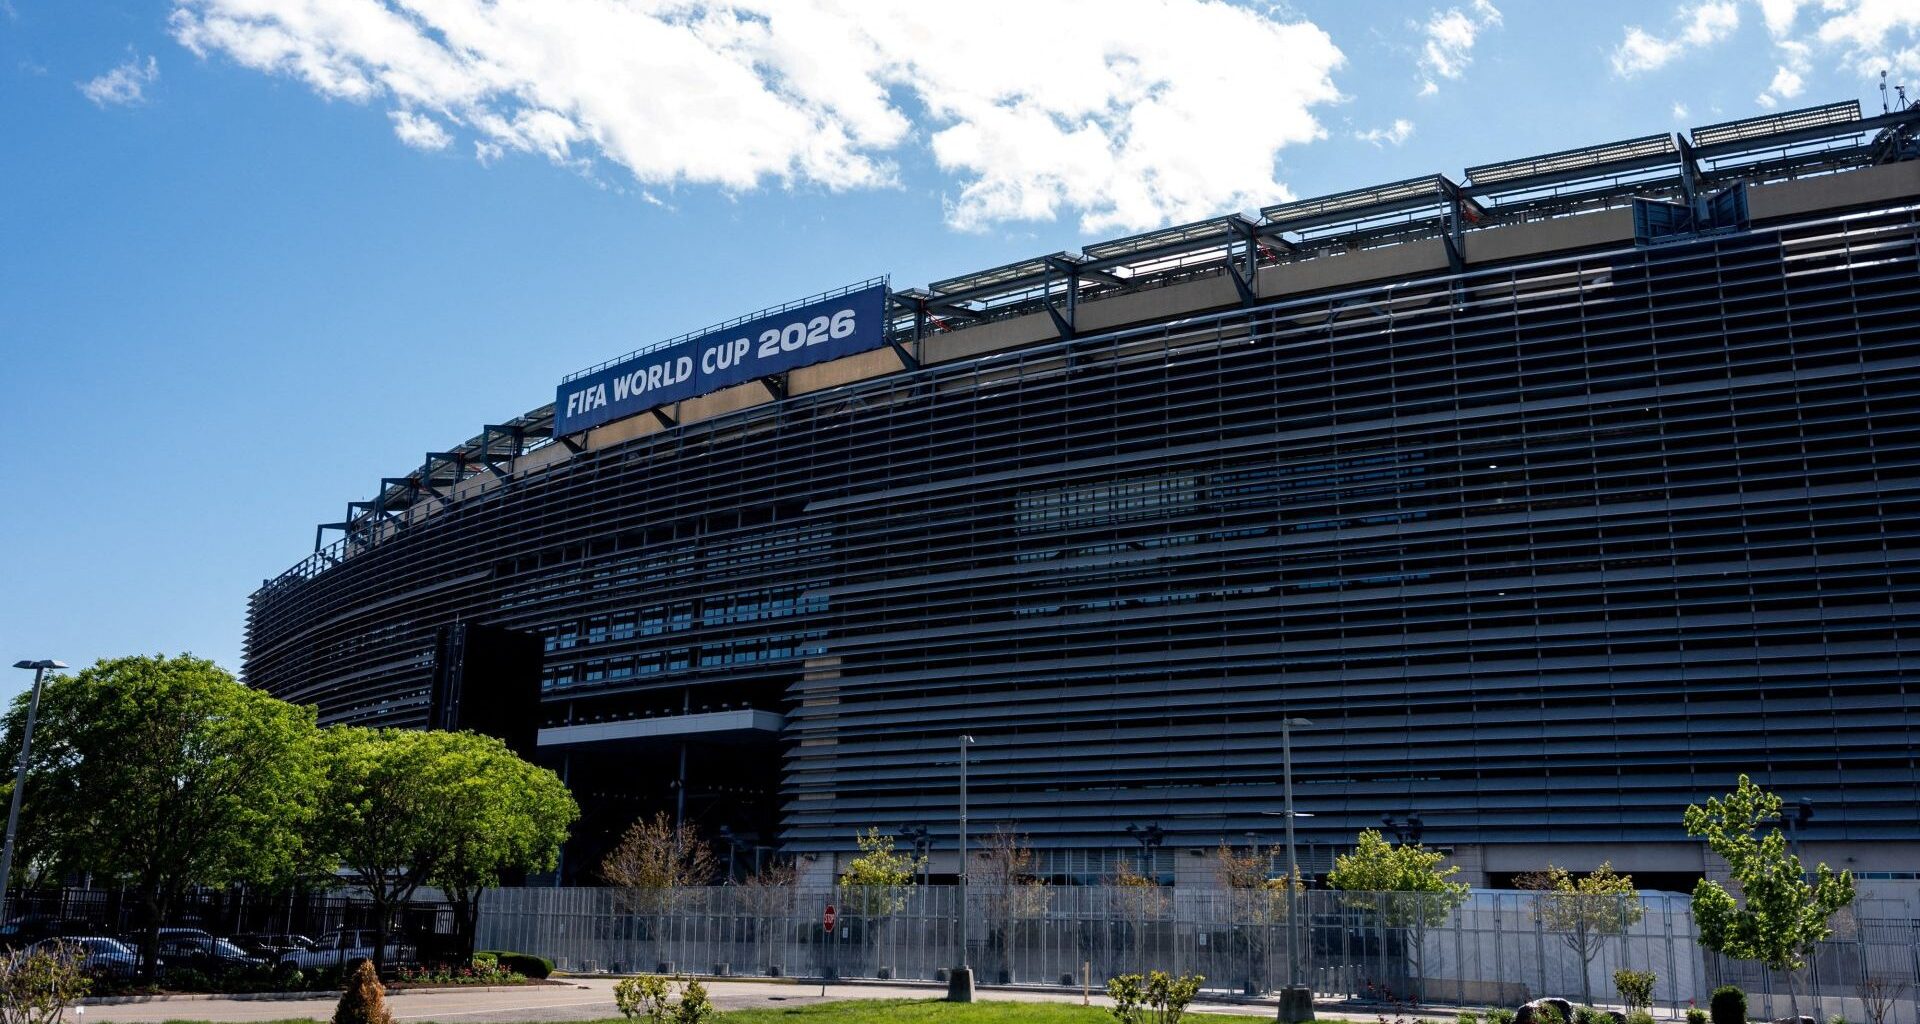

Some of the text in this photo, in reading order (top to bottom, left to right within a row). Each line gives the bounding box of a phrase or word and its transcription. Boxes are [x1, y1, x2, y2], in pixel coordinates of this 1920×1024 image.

[567, 310, 855, 417] FIFA WORLD CUP 2026
[825, 913, 835, 923] STOP
